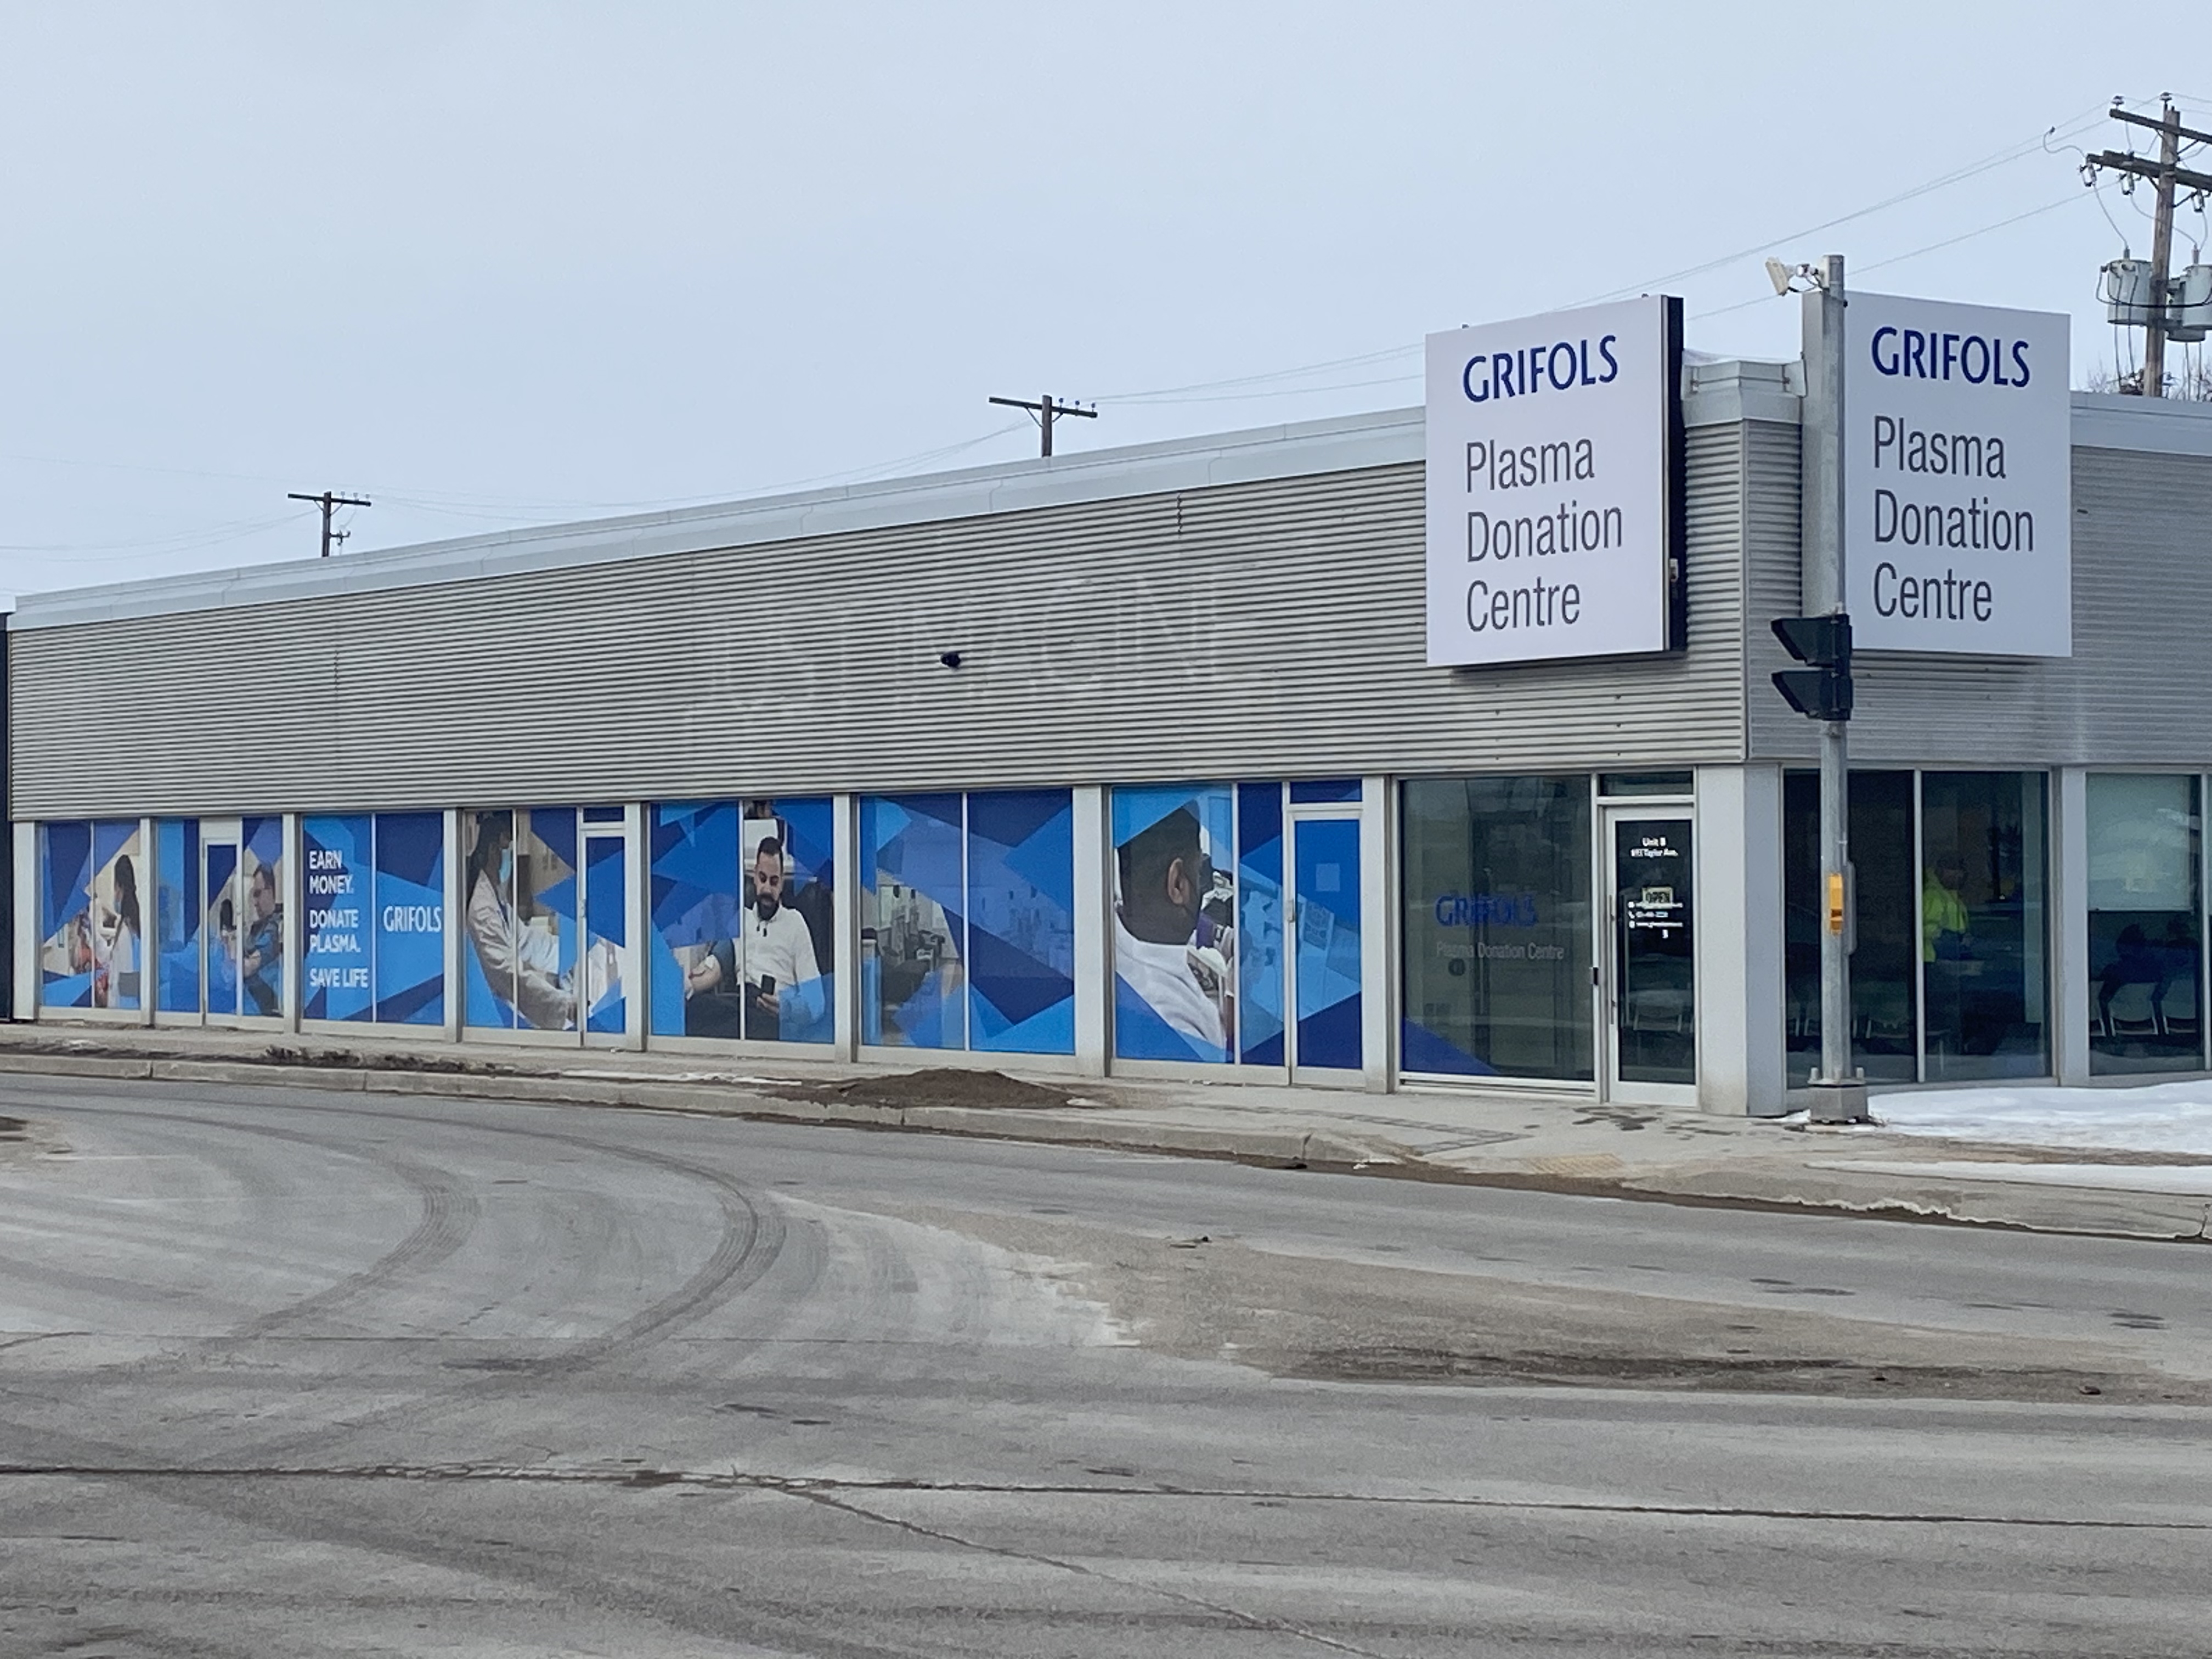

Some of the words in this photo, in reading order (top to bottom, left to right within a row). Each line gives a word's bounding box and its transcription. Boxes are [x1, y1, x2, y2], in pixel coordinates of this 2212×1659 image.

[1463, 335, 1618, 403] GRIFOLS
[1871, 326, 2030, 388] GRIFOLS
[1467, 439, 1595, 493] Plasma
[1875, 415, 2006, 479] Plasma
[1468, 500, 1622, 562] Donation
[1875, 489, 2034, 552] Donation
[1467, 576, 1581, 632] Centre
[1874, 562, 1992, 622] Centre
[309, 850, 343, 869] EARN
[309, 874, 354, 894] MONEY.
[309, 909, 359, 929] DONATE
[383, 905, 442, 933] GRIFOLS
[1435, 891, 1539, 927] GRIFOLS
[309, 934, 361, 953] PLASMA.
[1436, 941, 1475, 958] Plasma
[1478, 941, 1526, 959] Donation
[1527, 941, 1565, 960] Centre
[309, 968, 341, 988] SAVE
[342, 968, 369, 988] LIFE
